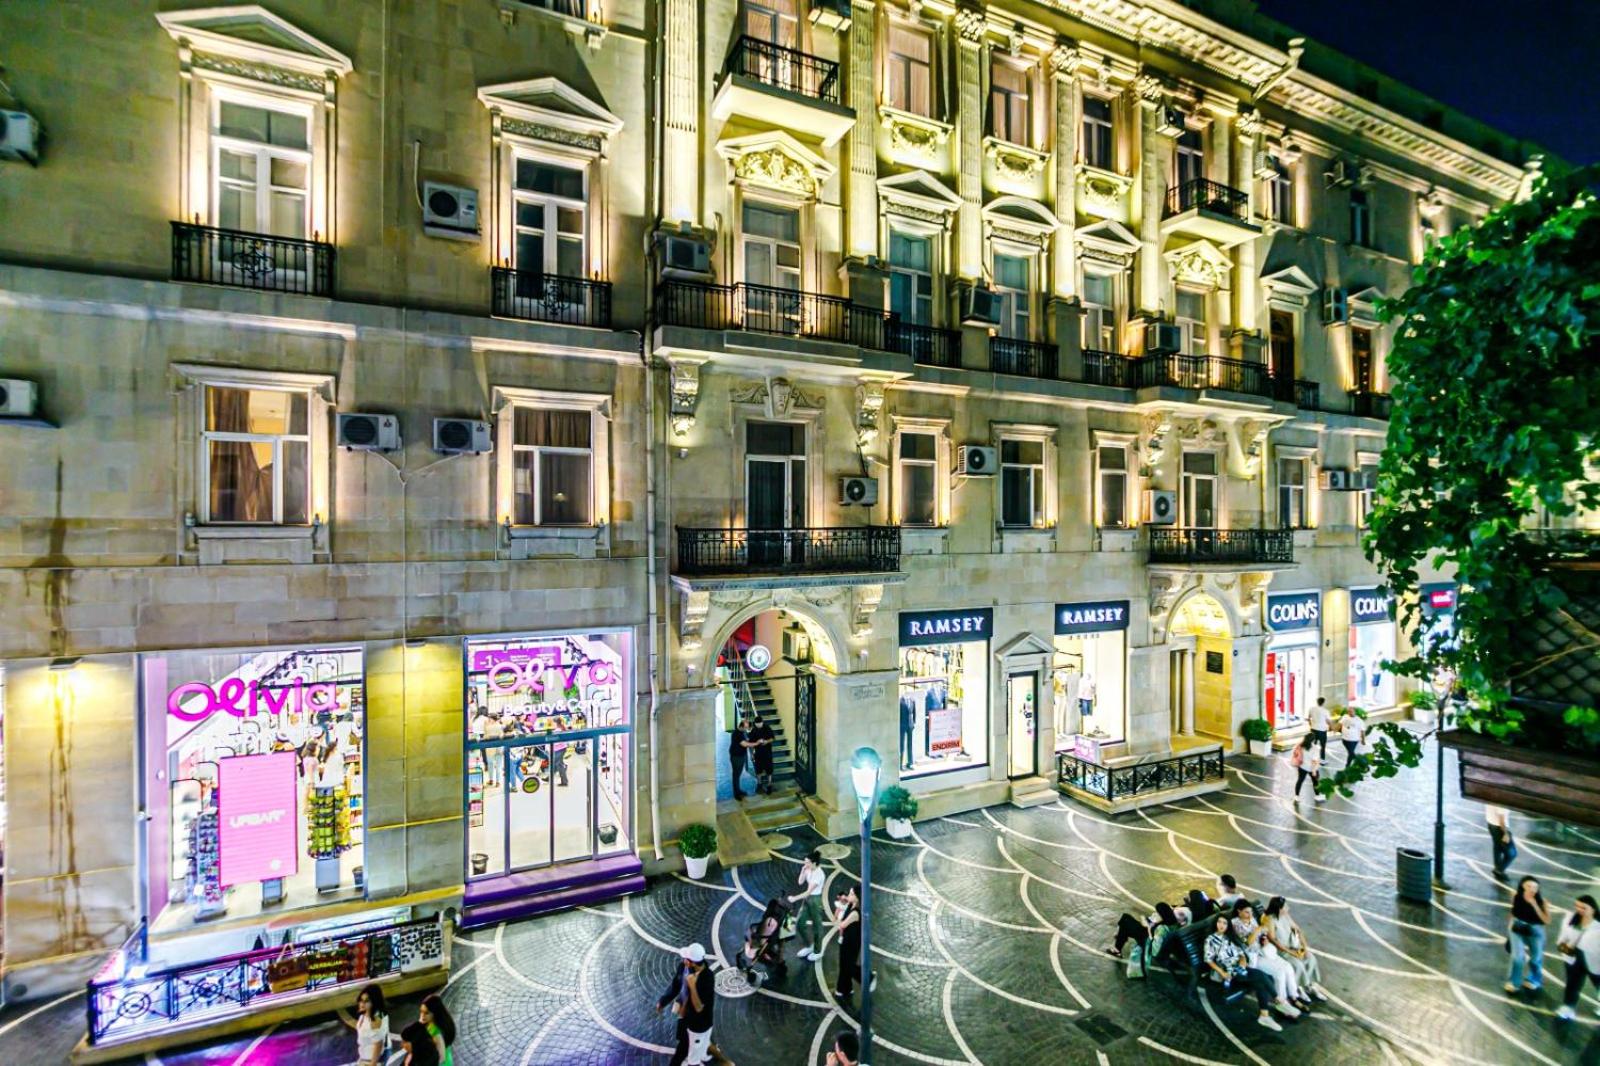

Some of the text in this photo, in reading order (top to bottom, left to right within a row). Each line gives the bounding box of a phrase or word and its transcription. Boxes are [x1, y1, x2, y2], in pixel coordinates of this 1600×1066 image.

[1062, 607, 1123, 625] RAMSEY
[1270, 599, 1318, 623] COLIN'S
[909, 616, 984, 636] RAMSEY
[488, 657, 616, 693] Olivia
[167, 676, 340, 722] Olivia
